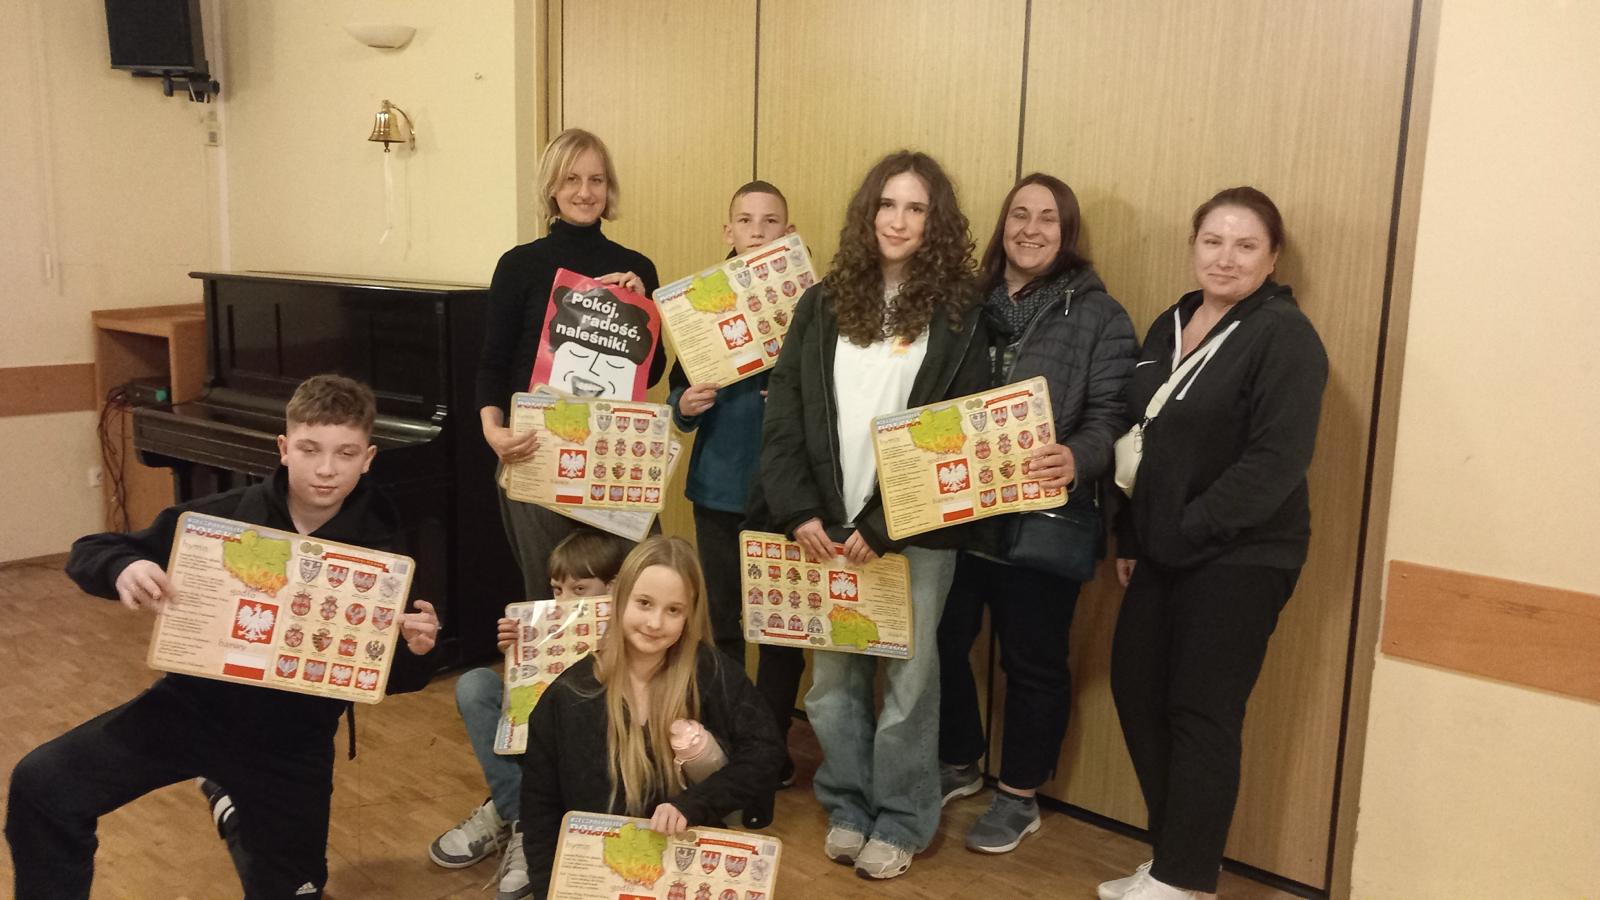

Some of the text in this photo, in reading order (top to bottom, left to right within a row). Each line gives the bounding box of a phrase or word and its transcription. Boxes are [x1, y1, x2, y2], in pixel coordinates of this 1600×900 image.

[571, 292, 619, 319] Pokój,
[555, 323, 630, 353] naleśniki.
[581, 314, 641, 341] radość,
[185, 523, 243, 544] POLSKA
[568, 823, 621, 838] POLSKA
